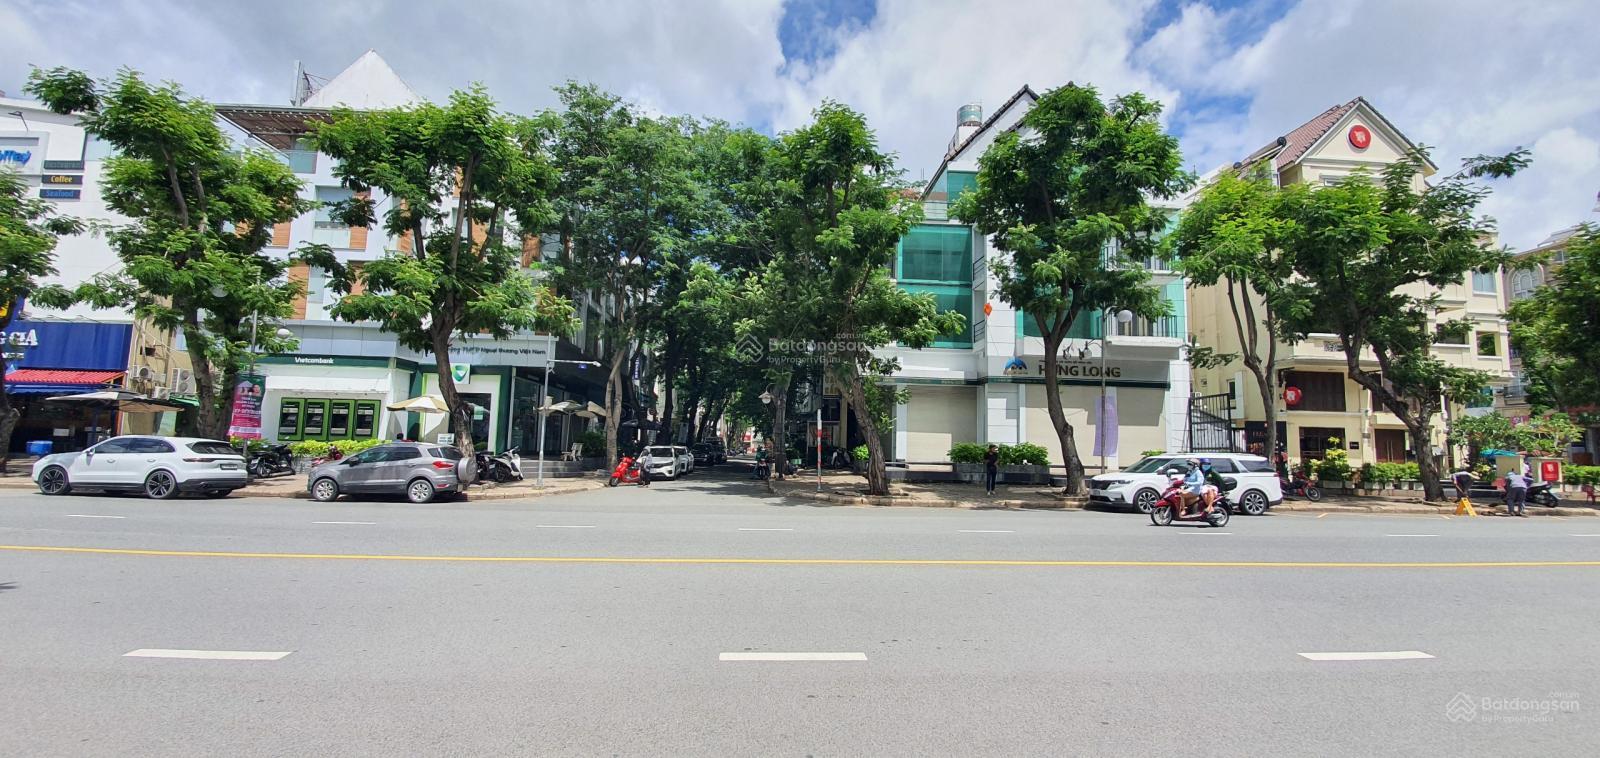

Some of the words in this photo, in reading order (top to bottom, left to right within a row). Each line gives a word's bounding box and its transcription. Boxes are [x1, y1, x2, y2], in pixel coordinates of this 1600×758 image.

[295, 356, 334, 364] Vietcombank
[1039, 364, 1079, 377] HNG
[1082, 366, 1121, 378] LONG
